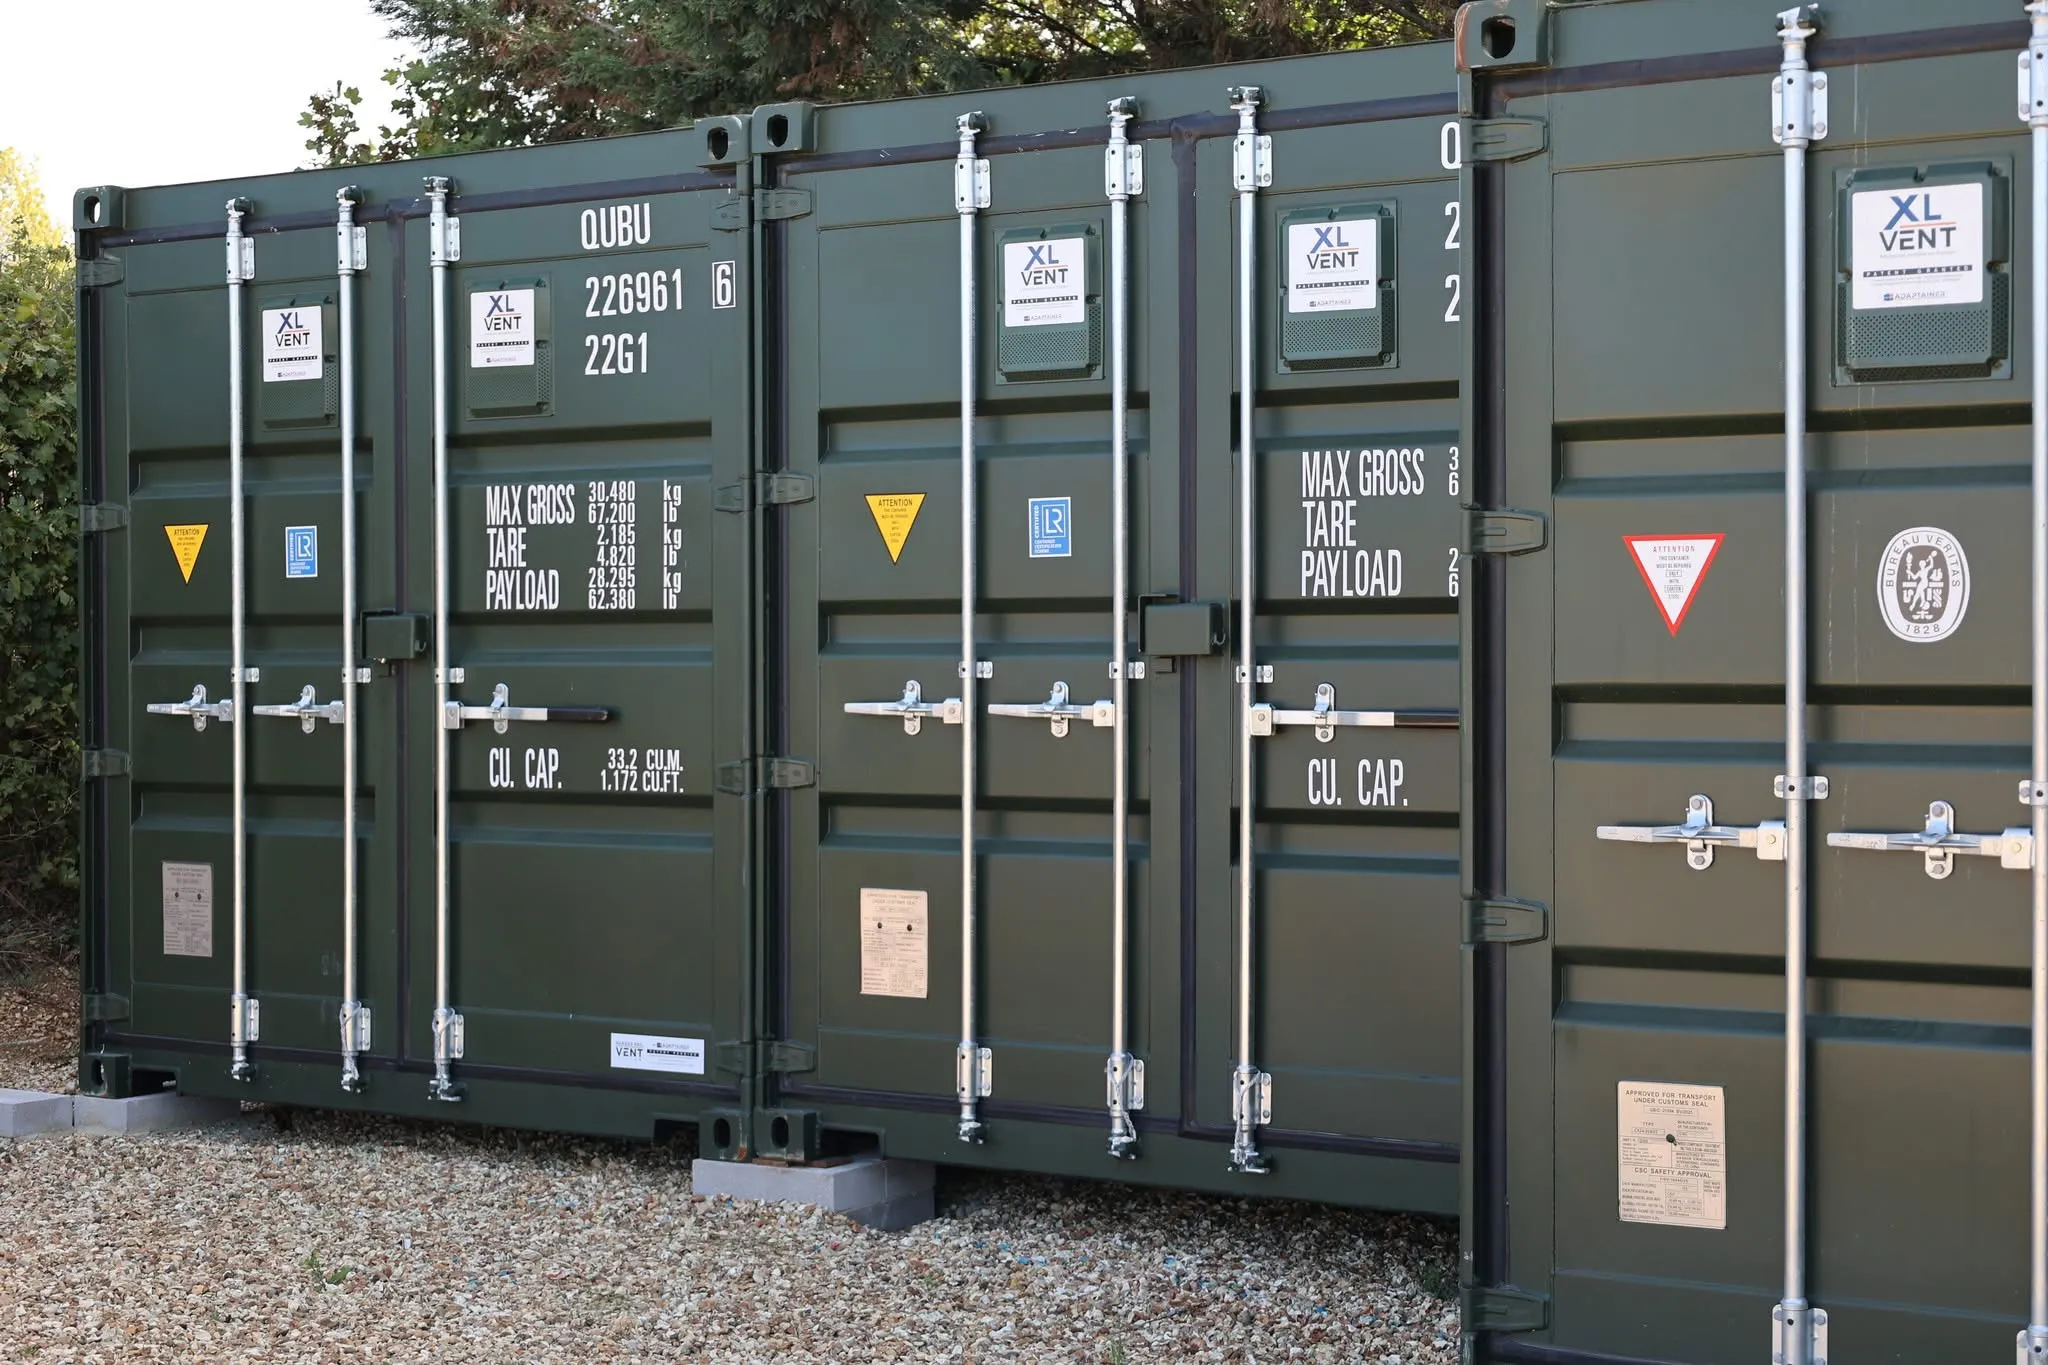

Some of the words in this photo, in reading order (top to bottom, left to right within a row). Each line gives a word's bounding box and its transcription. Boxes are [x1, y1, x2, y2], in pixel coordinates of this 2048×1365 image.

[1883, 193, 1942, 230] XL
[580, 203, 650, 250] QUBU
[1310, 226, 1349, 254] XL
[1879, 227, 1957, 251] VENT
[1024, 244, 1059, 271] XL
[1306, 251, 1359, 270] VENT
[1021, 268, 1068, 286] VENT
[1866, 269, 1908, 277] PATENT
[1917, 265, 1970, 274] GRANTED
[586, 268, 682, 318] 226961
[716, 264, 732, 306] 6
[1894, 290, 1946, 300] ADAPTAINER
[486, 294, 514, 318] XL
[277, 312, 304, 334] XL
[484, 316, 522, 331] VENT
[275, 332, 310, 347] VENT
[584, 332, 648, 376] 22G1
[1302, 450, 1350, 498] MAX
[1359, 448, 1424, 496] GROSS
[486, 485, 522, 526] MAX
[528, 484, 576, 524] GROSS
[588, 480, 636, 502] 30,480
[663, 480, 682, 506] kg
[878, 498, 913, 507] ATTENTION
[588, 502, 636, 524] 67,200
[663, 502, 678, 523] lb
[1046, 508, 1064, 534] LR
[1302, 500, 1356, 548] TARE
[298, 535, 312, 557] LR
[486, 528, 527, 568] TARE
[596, 524, 636, 546] 2,185
[663, 524, 682, 550] kg
[596, 545, 636, 567] 4,820
[663, 545, 678, 566] lb
[1886, 535, 1920, 587] BUREAU
[1926, 535, 1960, 588] VERITAS
[588, 567, 636, 588] 28,295
[663, 567, 682, 593] kg
[1302, 550, 1402, 596] PAYLOAD
[486, 570, 560, 610] PAYLOAD
[588, 588, 636, 610] 62,380
[663, 588, 678, 610] lb
[1905, 624, 1940, 634] 1828
[489, 748, 514, 788] CU.
[525, 748, 562, 789] CAP.
[608, 748, 638, 770] 33.2
[646, 749, 684, 771] CU.M.
[600, 769, 638, 791] 1,172
[642, 770, 684, 793] CU.FT.
[1308, 758, 1342, 806] CU.
[1358, 758, 1408, 806] CAP.
[616, 1047, 644, 1058] VENT
[1625, 1090, 1660, 1098] APPROVED
[1658, 1098, 1690, 1106] CUSTOMS
[1650, 1168, 1675, 1176] SAFETY
[1678, 1170, 1712, 1178] APPROVAL
